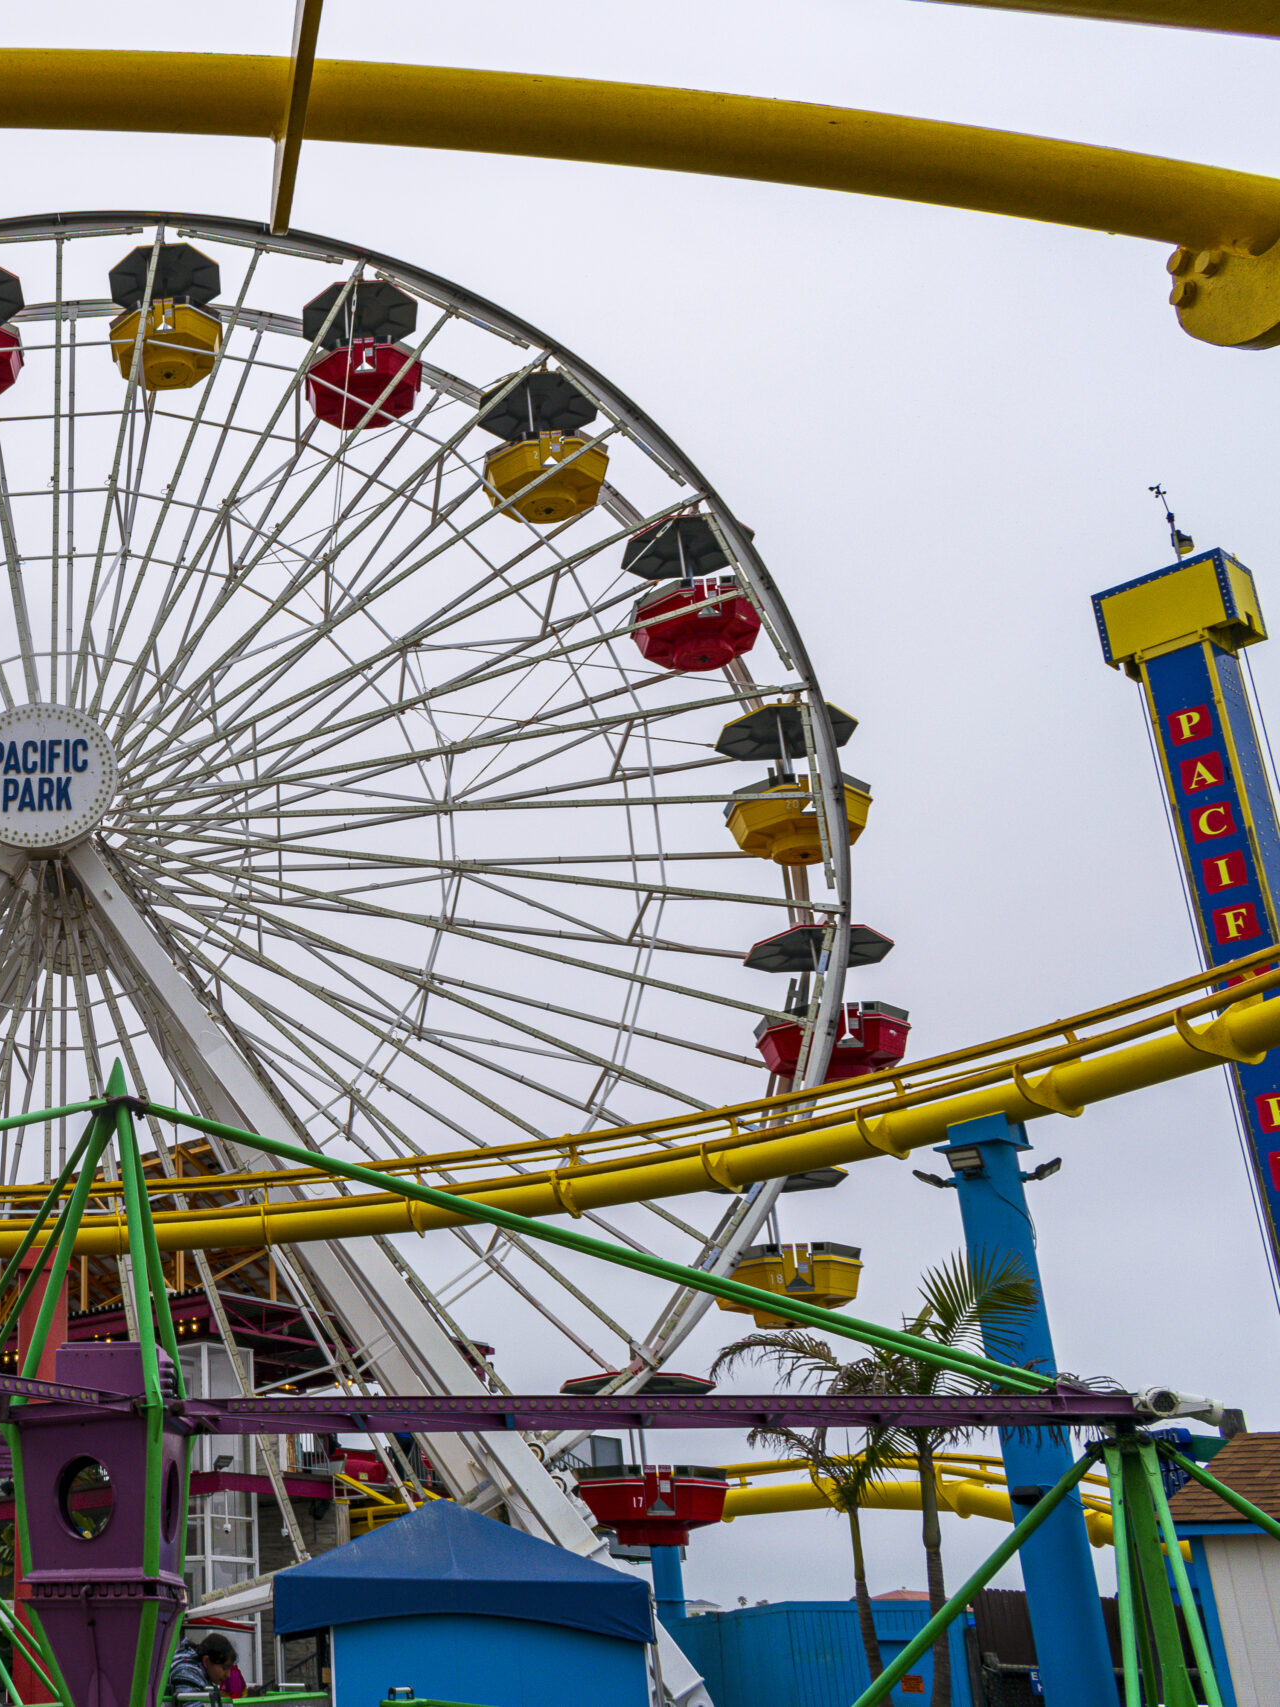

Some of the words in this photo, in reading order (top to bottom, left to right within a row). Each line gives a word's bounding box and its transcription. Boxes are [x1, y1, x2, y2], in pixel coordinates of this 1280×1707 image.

[533, 450, 539, 460] 2
[2, 776, 72, 812] PARK
[786, 799, 800, 809] 20
[1175, 710, 1250, 940] PACIF
[770, 1273, 784, 1285] 18
[633, 1496, 644, 1508] 17
